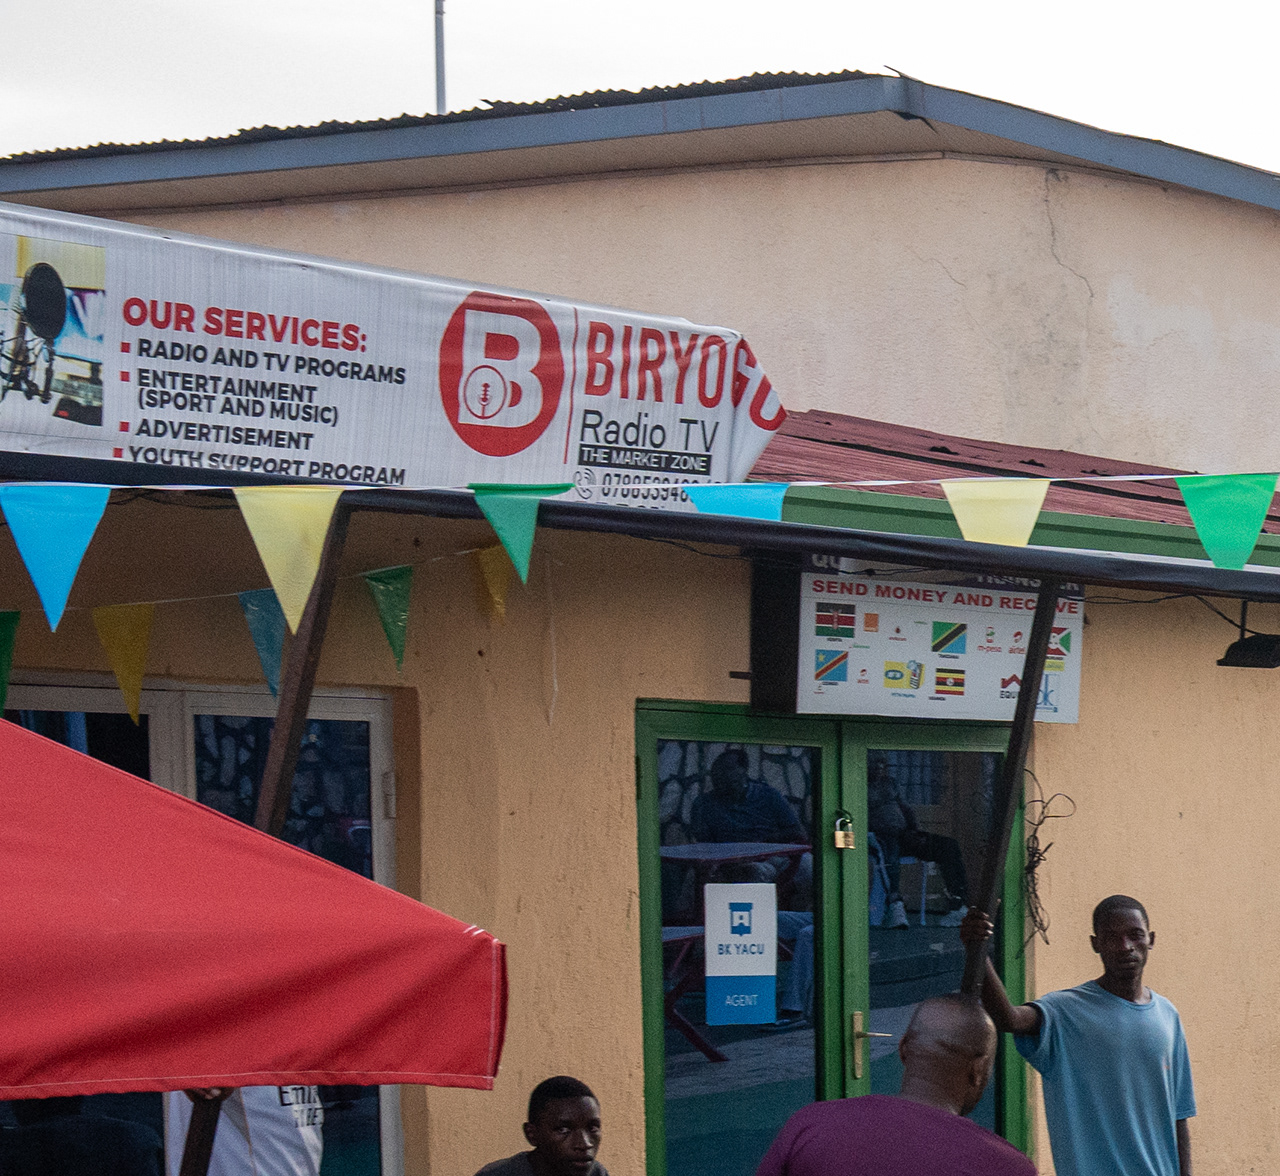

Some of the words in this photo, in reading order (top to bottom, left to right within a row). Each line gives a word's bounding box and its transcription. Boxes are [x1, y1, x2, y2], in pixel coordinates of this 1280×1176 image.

[122, 297, 195, 333] OUR
[202, 306, 367, 353] SERVICES:
[138, 338, 208, 363] RADIO
[211, 346, 258, 368] AND
[263, 352, 290, 372] TV
[294, 355, 406, 385] PROGRAMS
[137, 368, 317, 404] ENTERTAINMENT
[138, 387, 216, 413] (SPORT
[220, 396, 265, 418] AND
[269, 401, 338, 427] MUSIC)
[135, 418, 314, 450] ADVERTISEMENT
[580, 409, 666, 449] Radio
[679, 418, 719, 452] TV
[129, 445, 204, 469] YOUTH
[207, 452, 305, 477] SUPPORT
[308, 461, 406, 485] PROGRAM
[581, 447, 610, 463] THE
[611, 450, 668, 468] MARKET
[670, 456, 707, 471] ZONE
[812, 580, 868, 597] SEND
[875, 585, 948, 603] MONEY
[953, 593, 993, 608] AND
[1000, 597, 1078, 614] RECVE
[717, 943, 732, 955] BK
[734, 943, 765, 955] YACU
[725, 994, 758, 1007] AGENT
